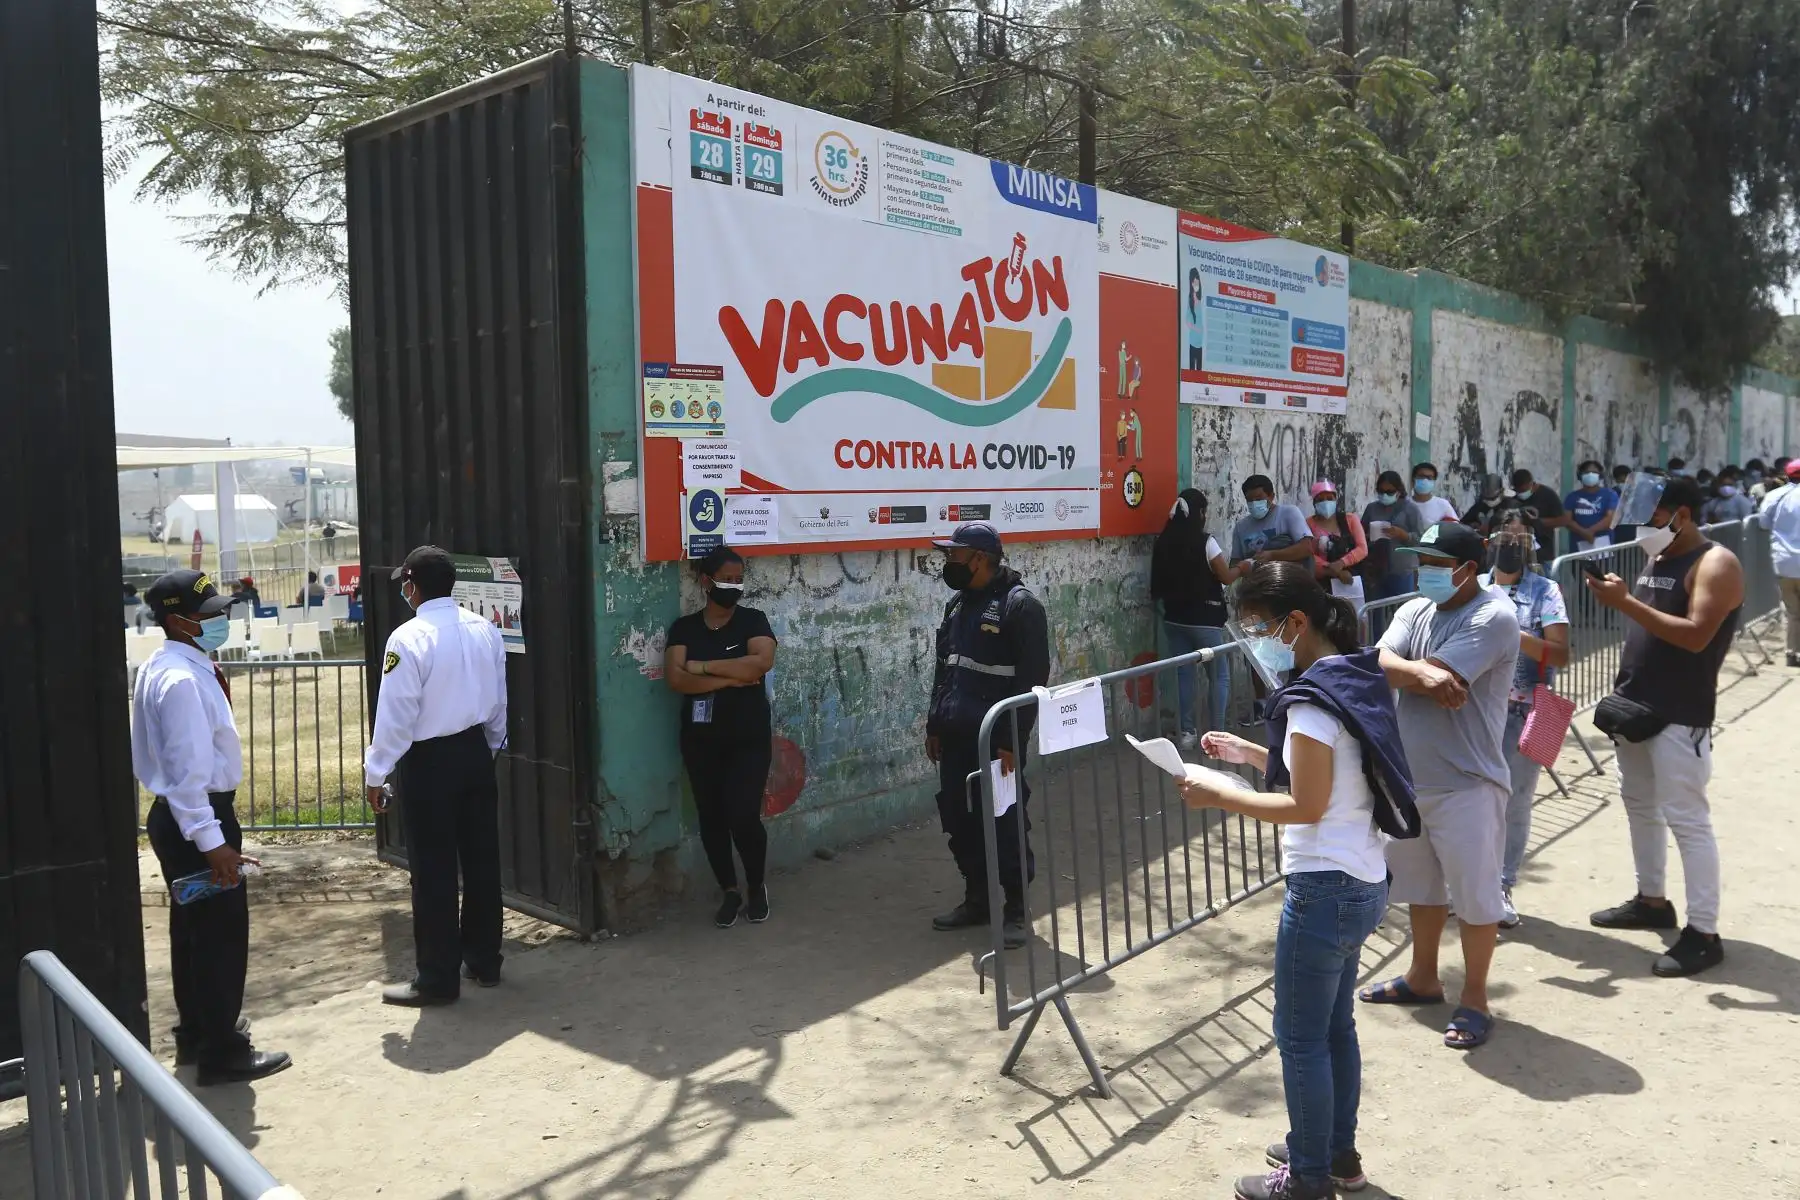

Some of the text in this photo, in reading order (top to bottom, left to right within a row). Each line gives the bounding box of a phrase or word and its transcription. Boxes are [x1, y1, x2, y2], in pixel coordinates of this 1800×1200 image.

[707, 93, 766, 117] A partir del:
[696, 122, 724, 134] sábado
[735, 133, 740, 143] EL
[748, 133, 778, 148] domingo
[700, 140, 724, 168] 28
[886, 141, 911, 154] Personas
[824, 144, 848, 169] 36
[887, 152, 908, 162] primera
[752, 152, 775, 179] 29
[887, 162, 912, 174] Personas
[828, 168, 848, 184] hrs.
[887, 173, 909, 183] primera
[915, 180, 937, 190] segunda
[887, 184, 911, 195] Mayores
[1008, 164, 1082, 211] MINSA
[887, 206, 916, 218] Gestantes
[922, 214, 938, 222] partir
[1188, 244, 1313, 284] Vacunación contra la COVID-19 para mujeres
[1200, 263, 1306, 293] con más de 28 semanas de gestación
[1228, 286, 1246, 297] Mayores
[834, 438, 1076, 470] CONTRA LA COVID-19
[800, 520, 826, 528] Gobierno
[827, 520, 836, 528] del
[1061, 704, 1078, 714] DOSIS
[1062, 718, 1078, 726] PFIZER
